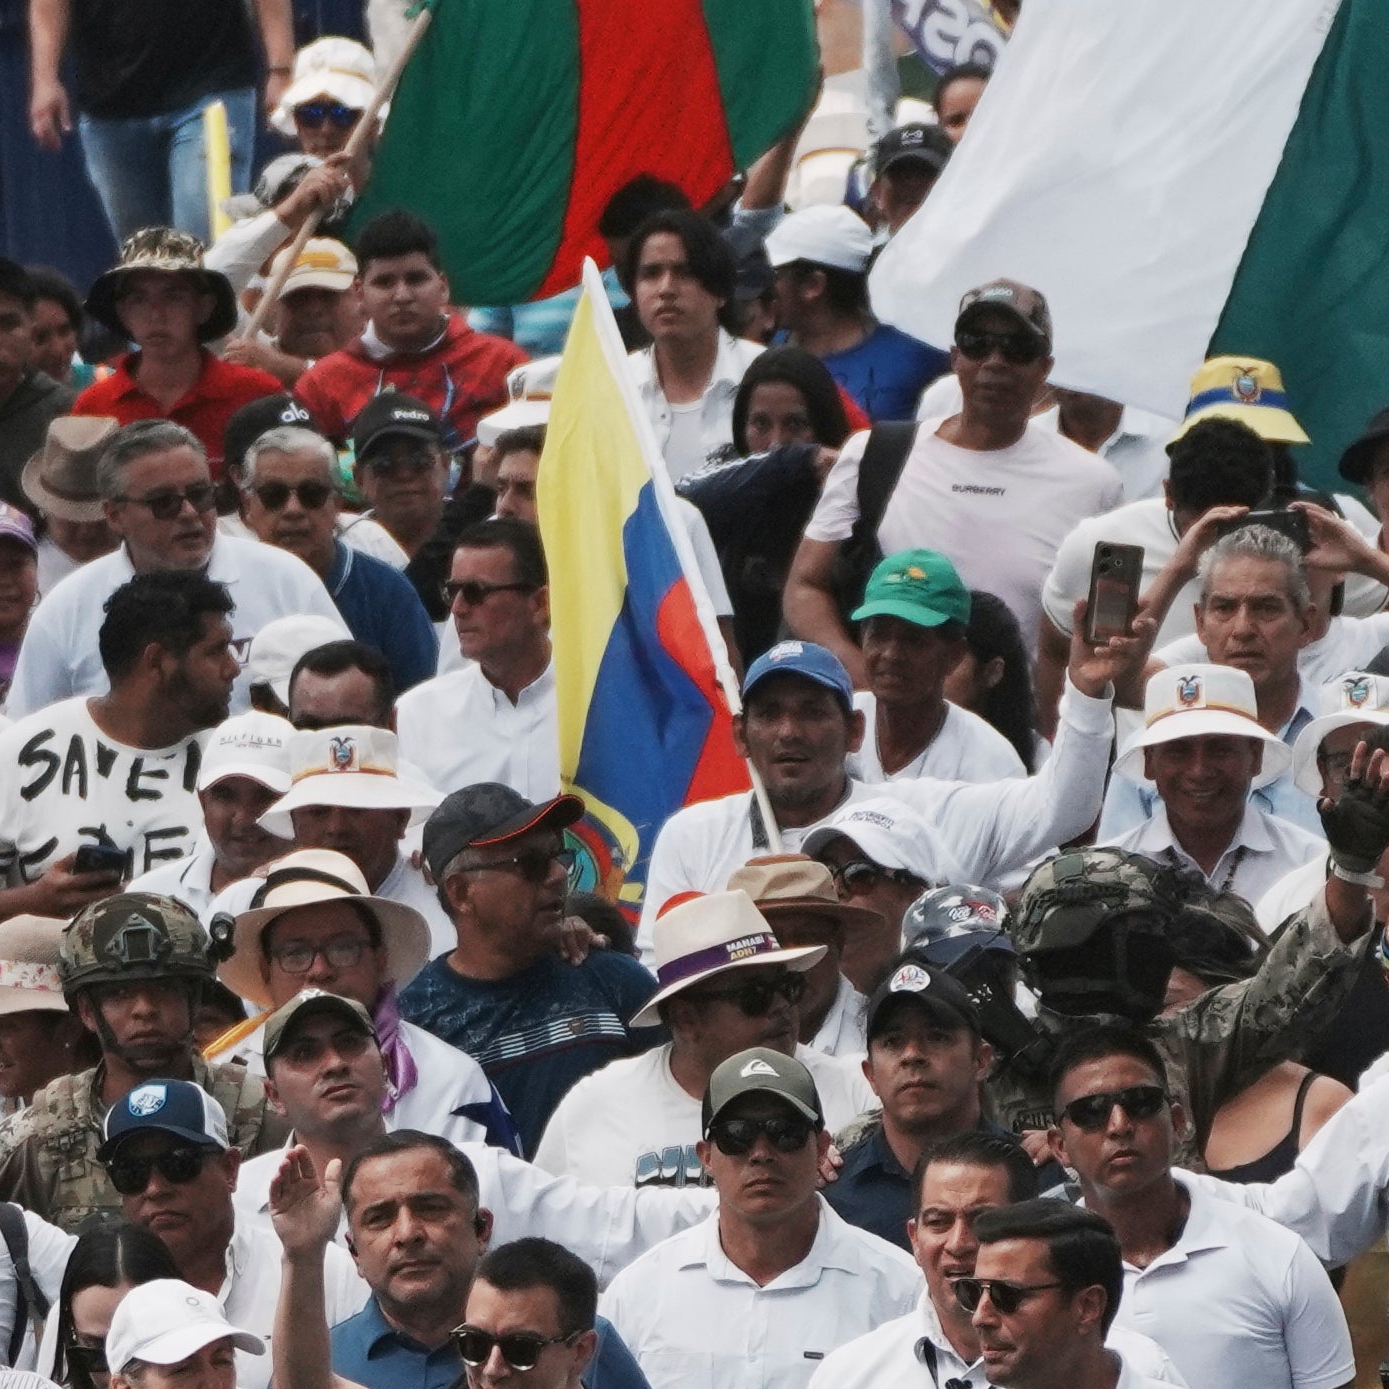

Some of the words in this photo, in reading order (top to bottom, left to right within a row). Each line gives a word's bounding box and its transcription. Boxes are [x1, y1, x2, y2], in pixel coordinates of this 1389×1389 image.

[281, 402, 310, 423] alo
[393, 410, 430, 421] Pedro
[952, 484, 1006, 496] BURBERRY
